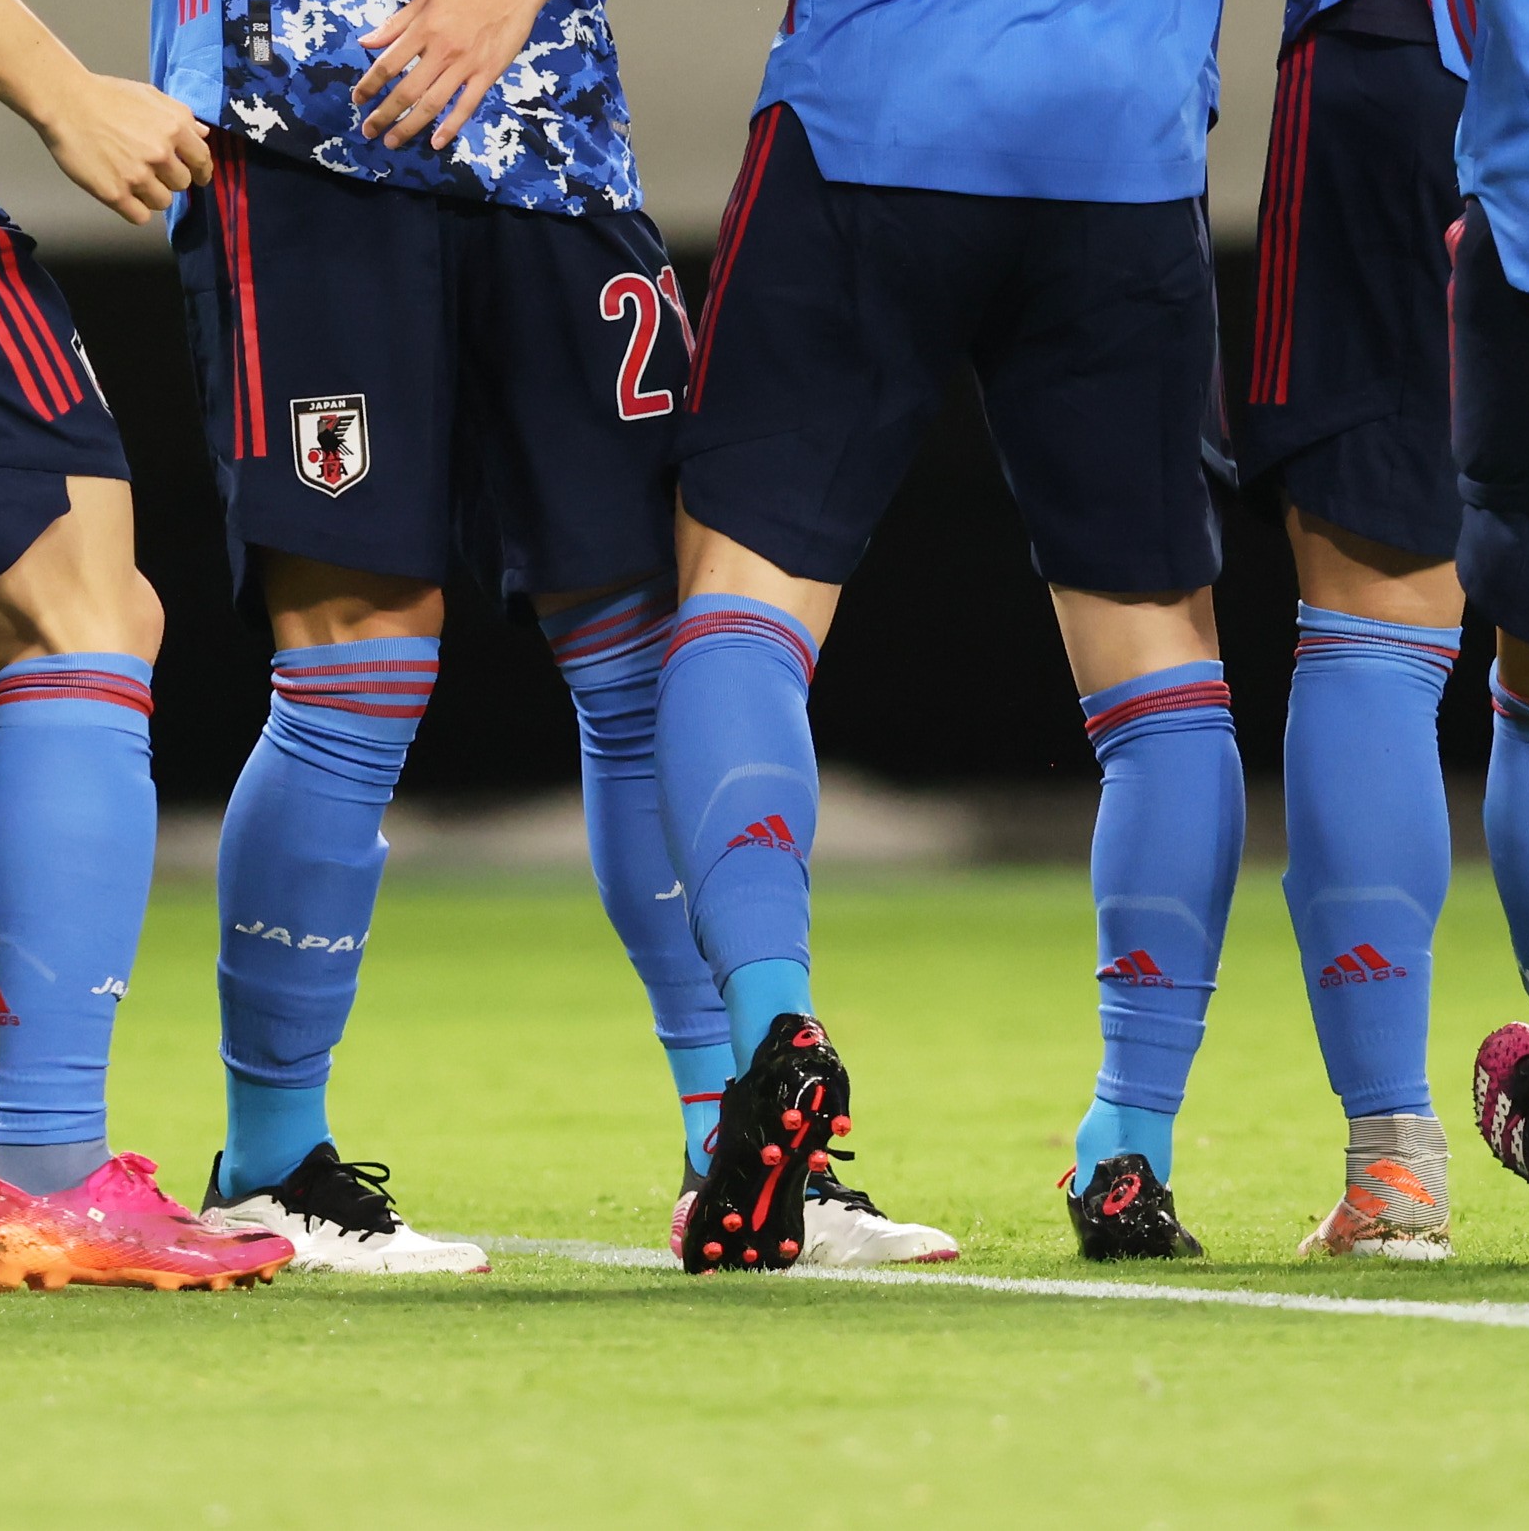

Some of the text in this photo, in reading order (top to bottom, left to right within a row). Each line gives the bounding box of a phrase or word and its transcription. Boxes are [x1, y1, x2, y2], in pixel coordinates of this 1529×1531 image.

[308, 399, 347, 411] JAPAN
[316, 462, 349, 479] JFA
[1319, 966, 1407, 989] adidas
